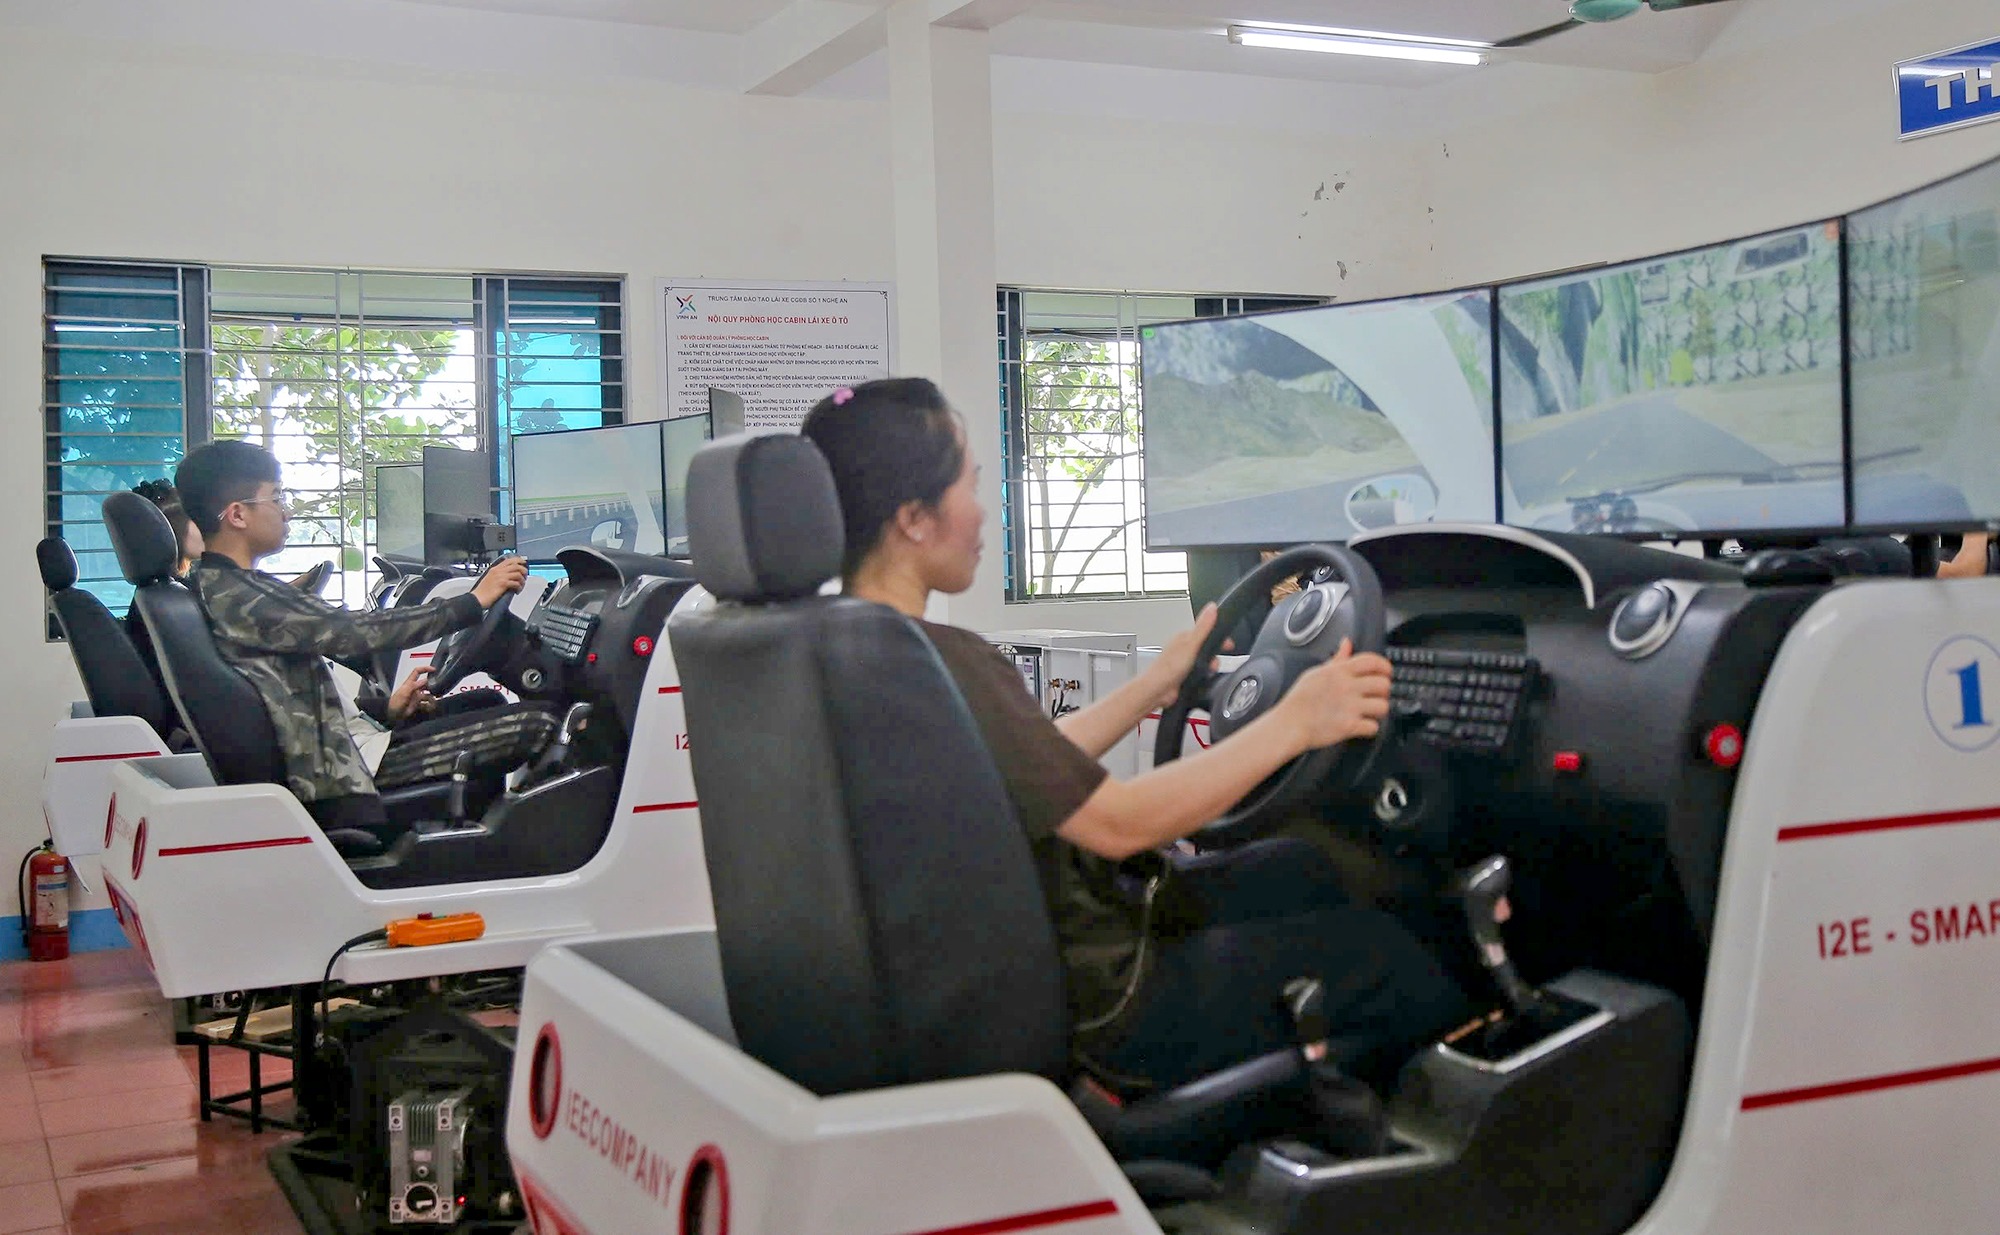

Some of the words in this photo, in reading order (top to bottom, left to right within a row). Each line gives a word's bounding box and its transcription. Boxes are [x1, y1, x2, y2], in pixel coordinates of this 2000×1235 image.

[1947, 656, 1993, 730] 1
[1817, 917, 1873, 961] I2E
[565, 1089, 677, 1209] IEECOMPANY
